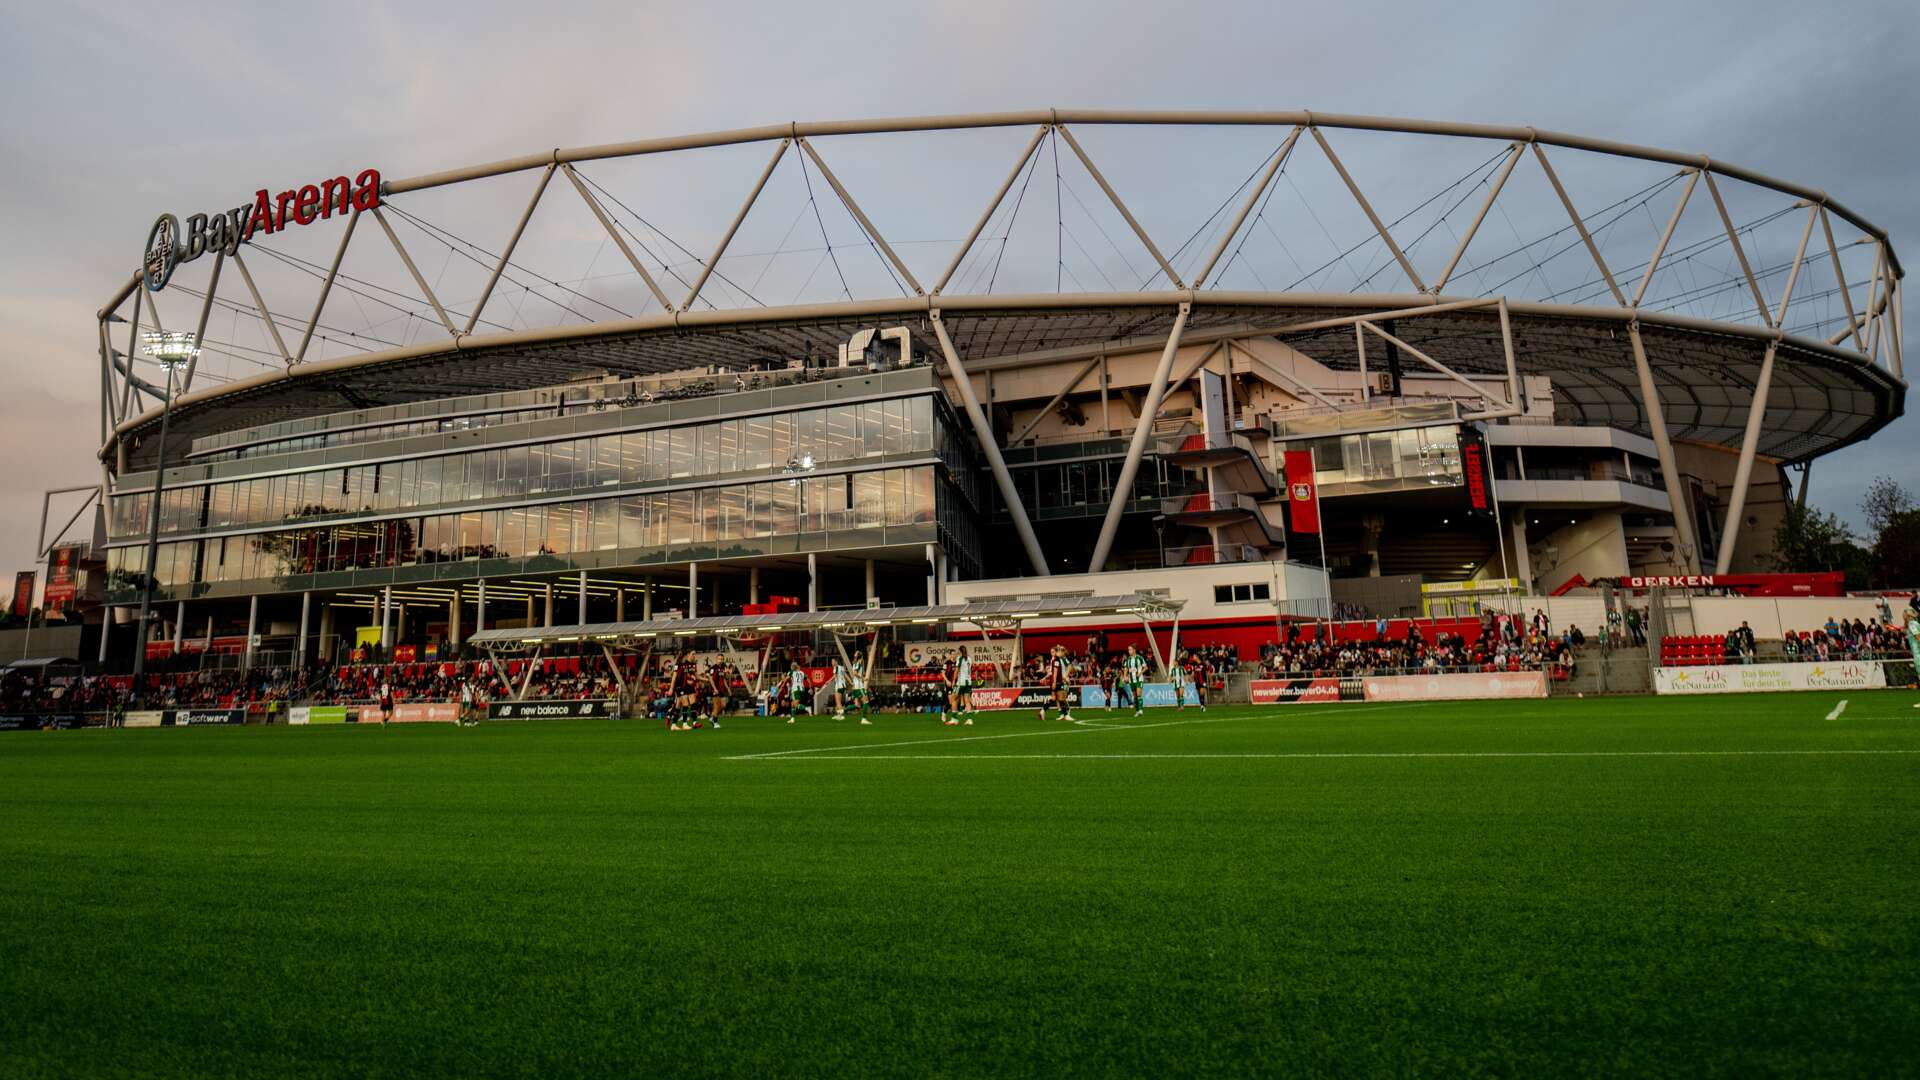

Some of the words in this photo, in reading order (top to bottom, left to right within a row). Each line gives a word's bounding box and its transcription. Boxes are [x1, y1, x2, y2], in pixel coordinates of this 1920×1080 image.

[183, 168, 381, 263] BayArena
[146, 242, 173, 264] BAYER
[1631, 575, 1714, 588] GERKEN
[1158, 689, 1194, 701] NIEX
[1253, 684, 1339, 698] newsletter.bayer04.de
[1017, 692, 1078, 704] app.bay.de
[520, 707, 536, 715] new
[537, 705, 569, 715] balance
